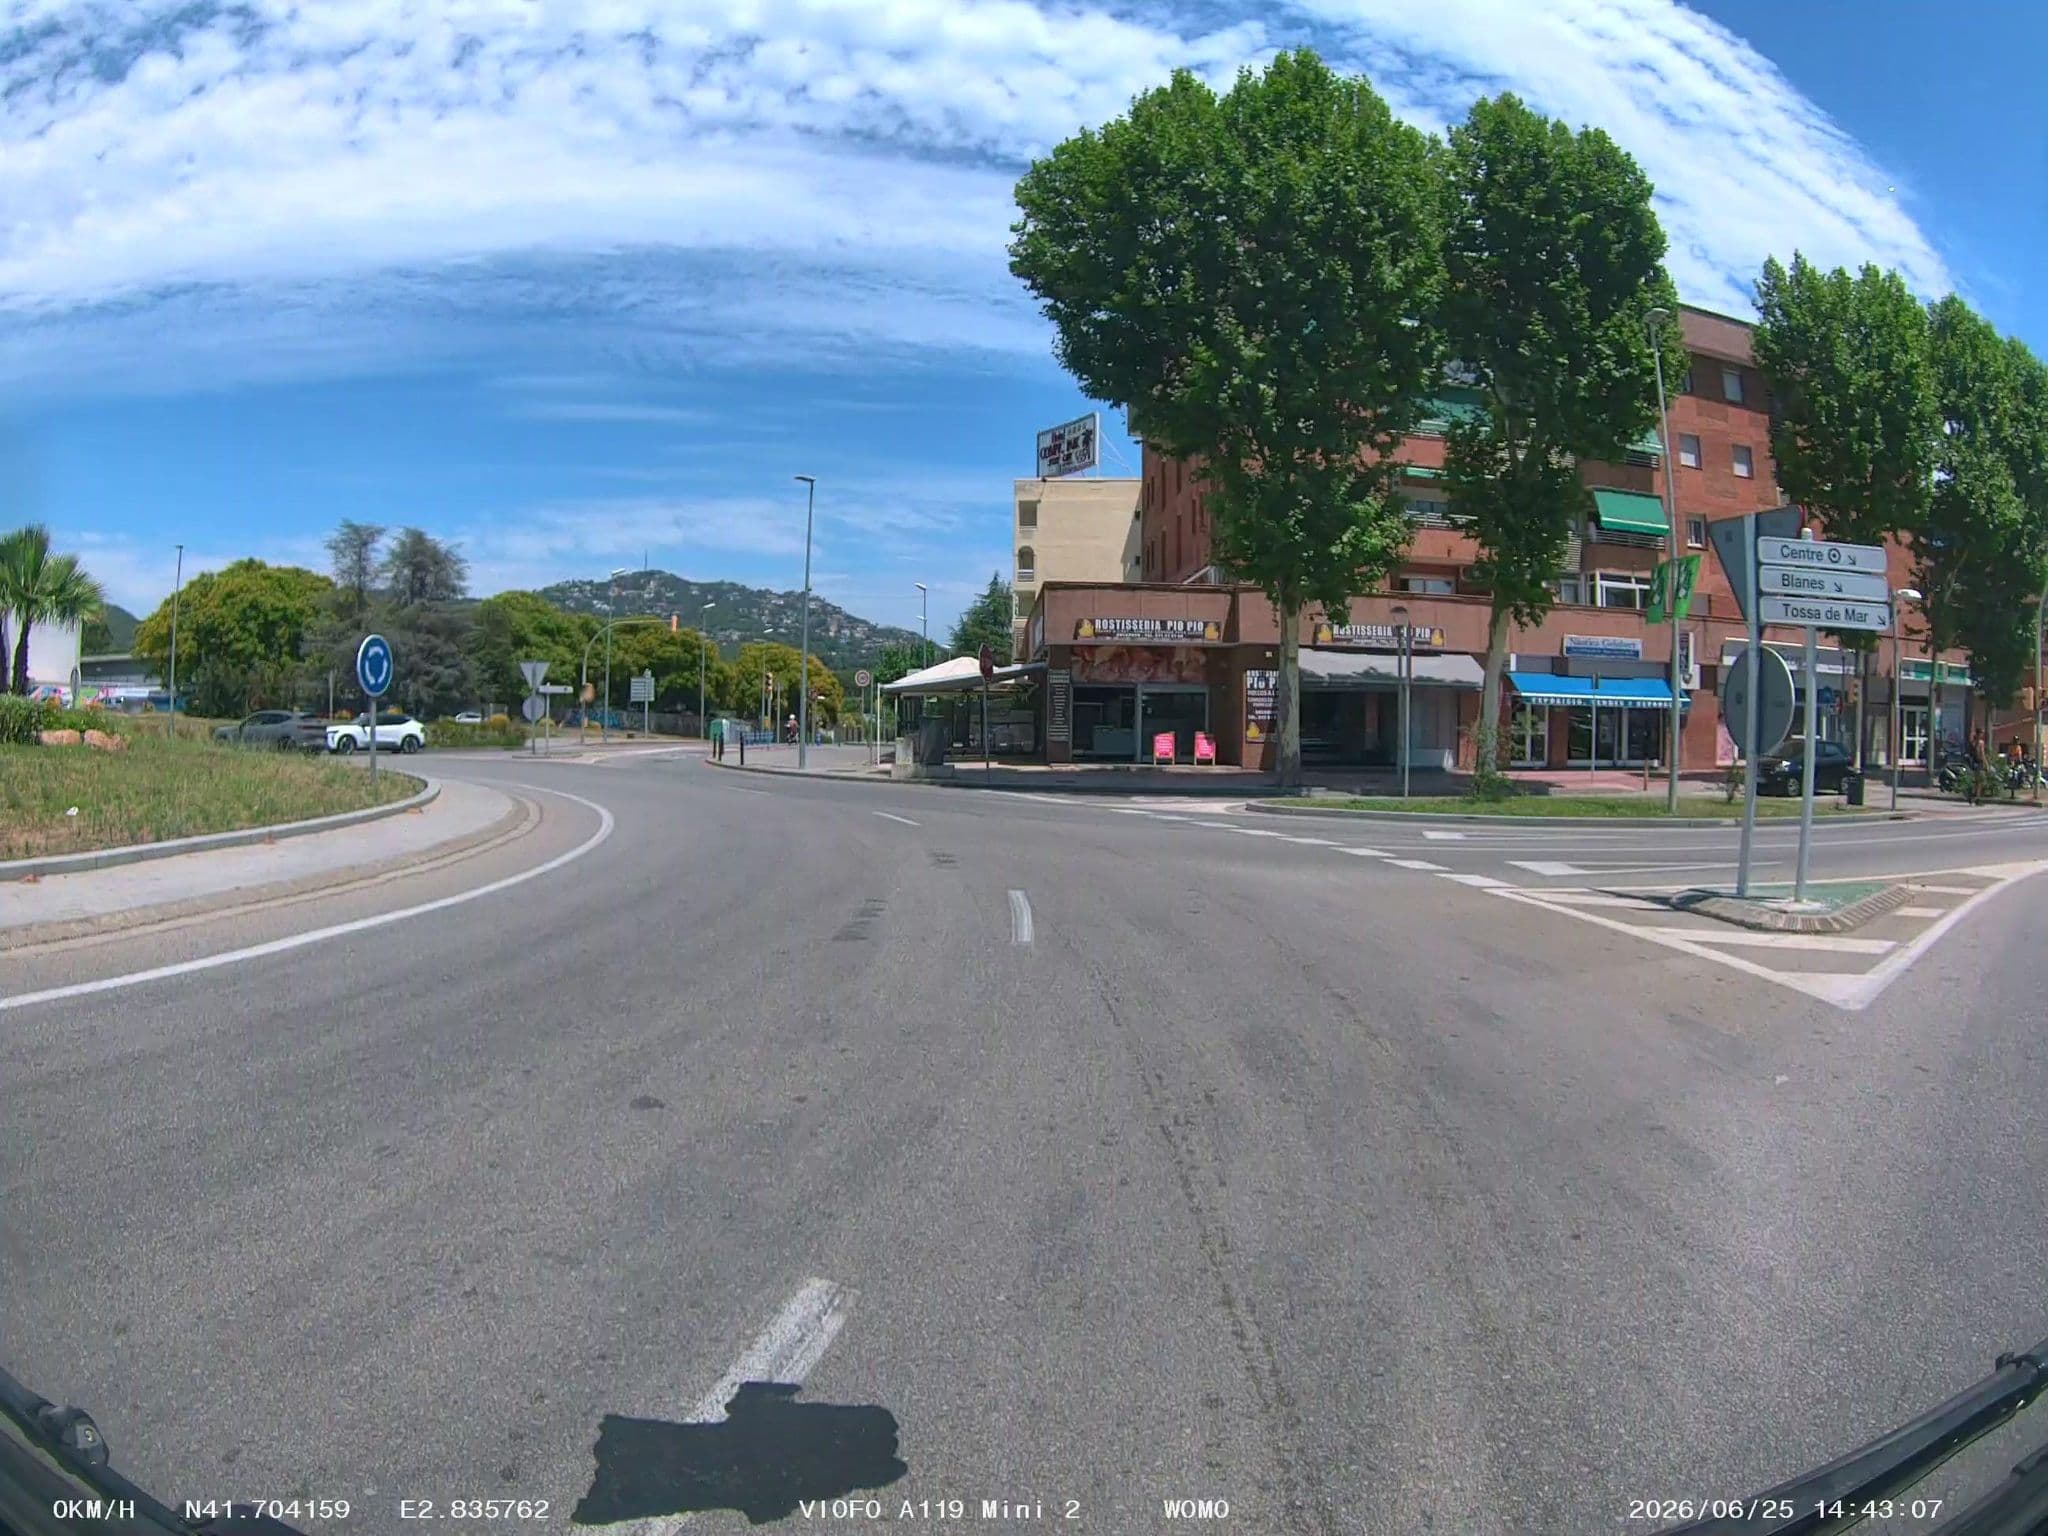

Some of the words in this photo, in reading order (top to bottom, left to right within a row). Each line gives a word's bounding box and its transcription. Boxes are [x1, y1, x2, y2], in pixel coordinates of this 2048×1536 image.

[1781, 545, 1824, 561] Centre
[1782, 573, 1825, 590] Blanes
[1782, 603, 1821, 620] Tossa
[1825, 606, 1841, 620] de
[1844, 607, 1869, 623] Mar
[1095, 619, 1161, 631] ROSTISSERIA
[1167, 620, 1184, 631] PIO
[1187, 620, 1204, 632] PIO
[1415, 627, 1431, 638] PIO
[1247, 677, 1265, 689] PIO
